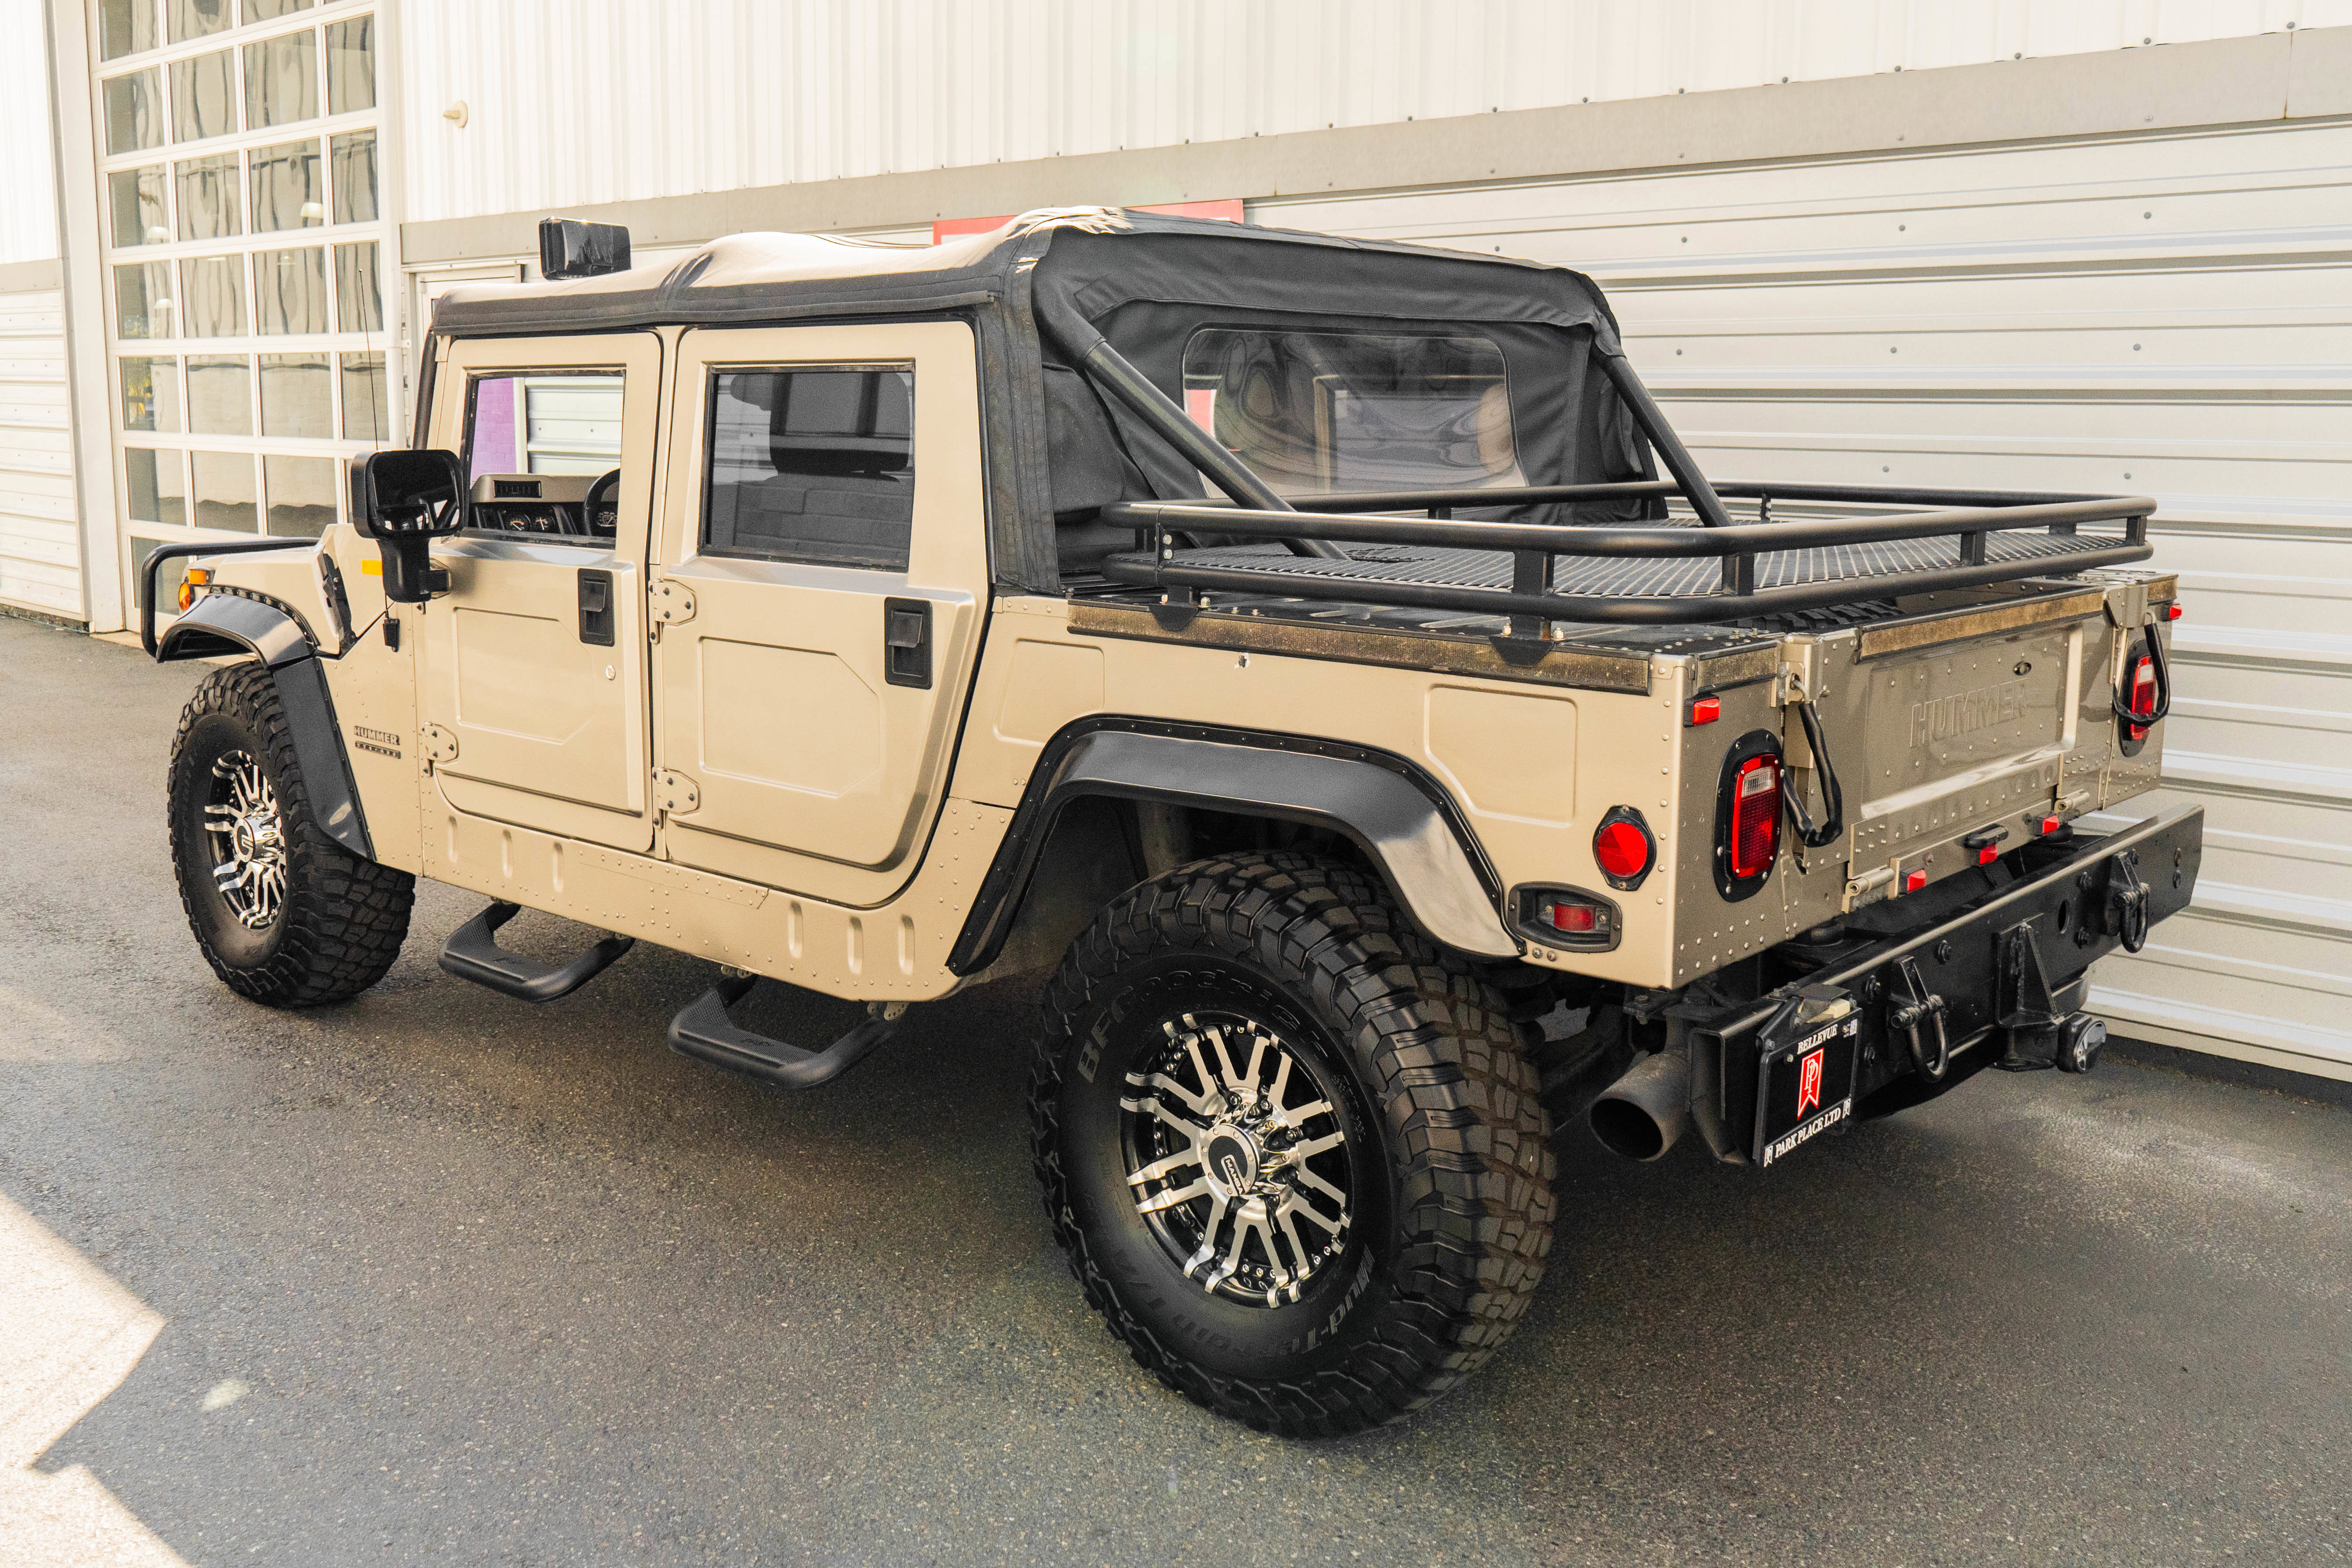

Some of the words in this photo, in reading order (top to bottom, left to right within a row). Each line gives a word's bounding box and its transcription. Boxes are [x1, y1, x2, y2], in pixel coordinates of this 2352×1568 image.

[1910, 678, 2028, 747] HUMMER
[354, 726, 400, 745] HUMMER
[1797, 1024, 1837, 1054] BELLEVUE
[1775, 1133, 1797, 1158] PARK
[1797, 1117, 1824, 1144] PLACE
[1824, 1108, 1841, 1128] LTD
[1226, 1159, 1243, 1195] MAMBA
